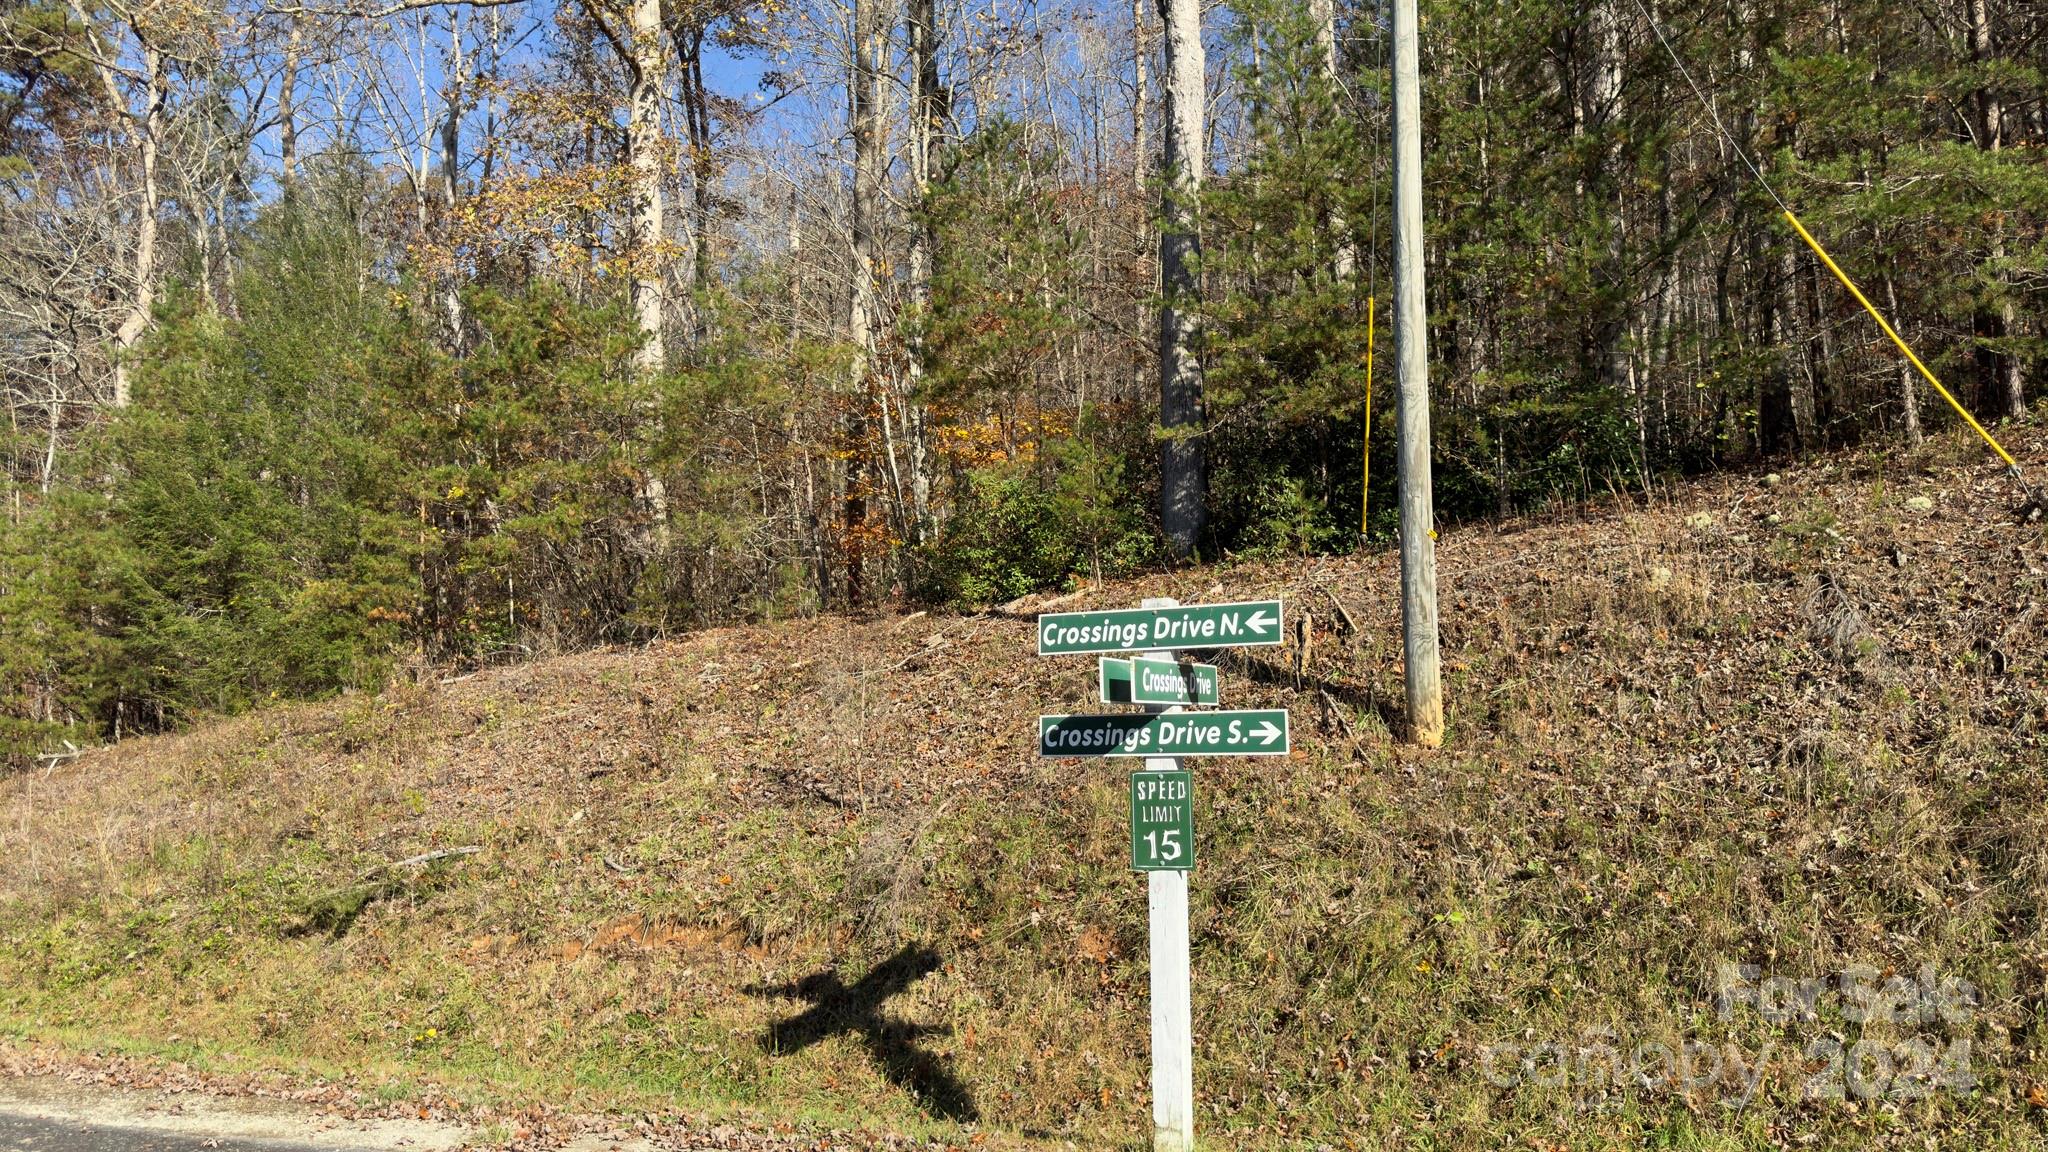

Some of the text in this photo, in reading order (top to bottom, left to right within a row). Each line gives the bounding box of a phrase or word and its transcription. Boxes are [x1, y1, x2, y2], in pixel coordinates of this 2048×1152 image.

[1043, 612, 1244, 647] Crossings Drive N.
[1142, 667, 1211, 699] Crossings Drive
[1045, 719, 1248, 752] Crossings Drive S.
[1137, 781, 1186, 800] SPEED
[1142, 806, 1181, 822] LIMIT
[1143, 829, 1181, 860] 15
